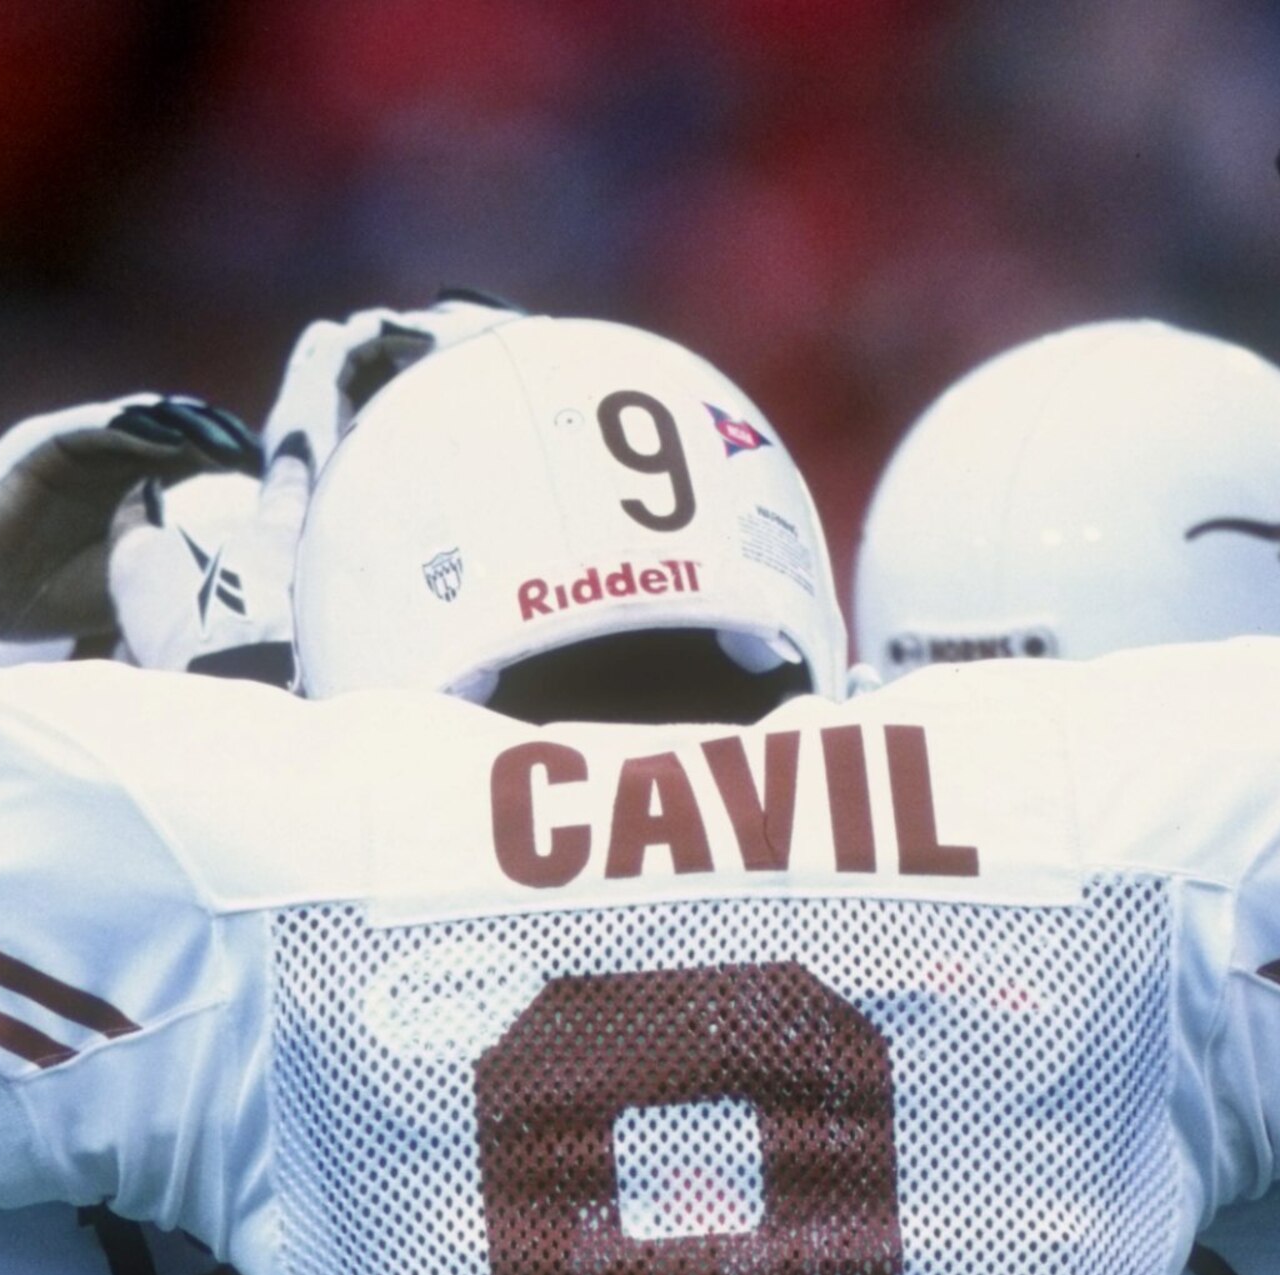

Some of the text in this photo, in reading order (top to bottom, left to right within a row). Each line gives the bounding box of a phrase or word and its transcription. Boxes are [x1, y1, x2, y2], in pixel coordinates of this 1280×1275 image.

[596, 390, 696, 532] 9
[517, 560, 699, 622] Riddell
[489, 724, 980, 888] CAVIL
